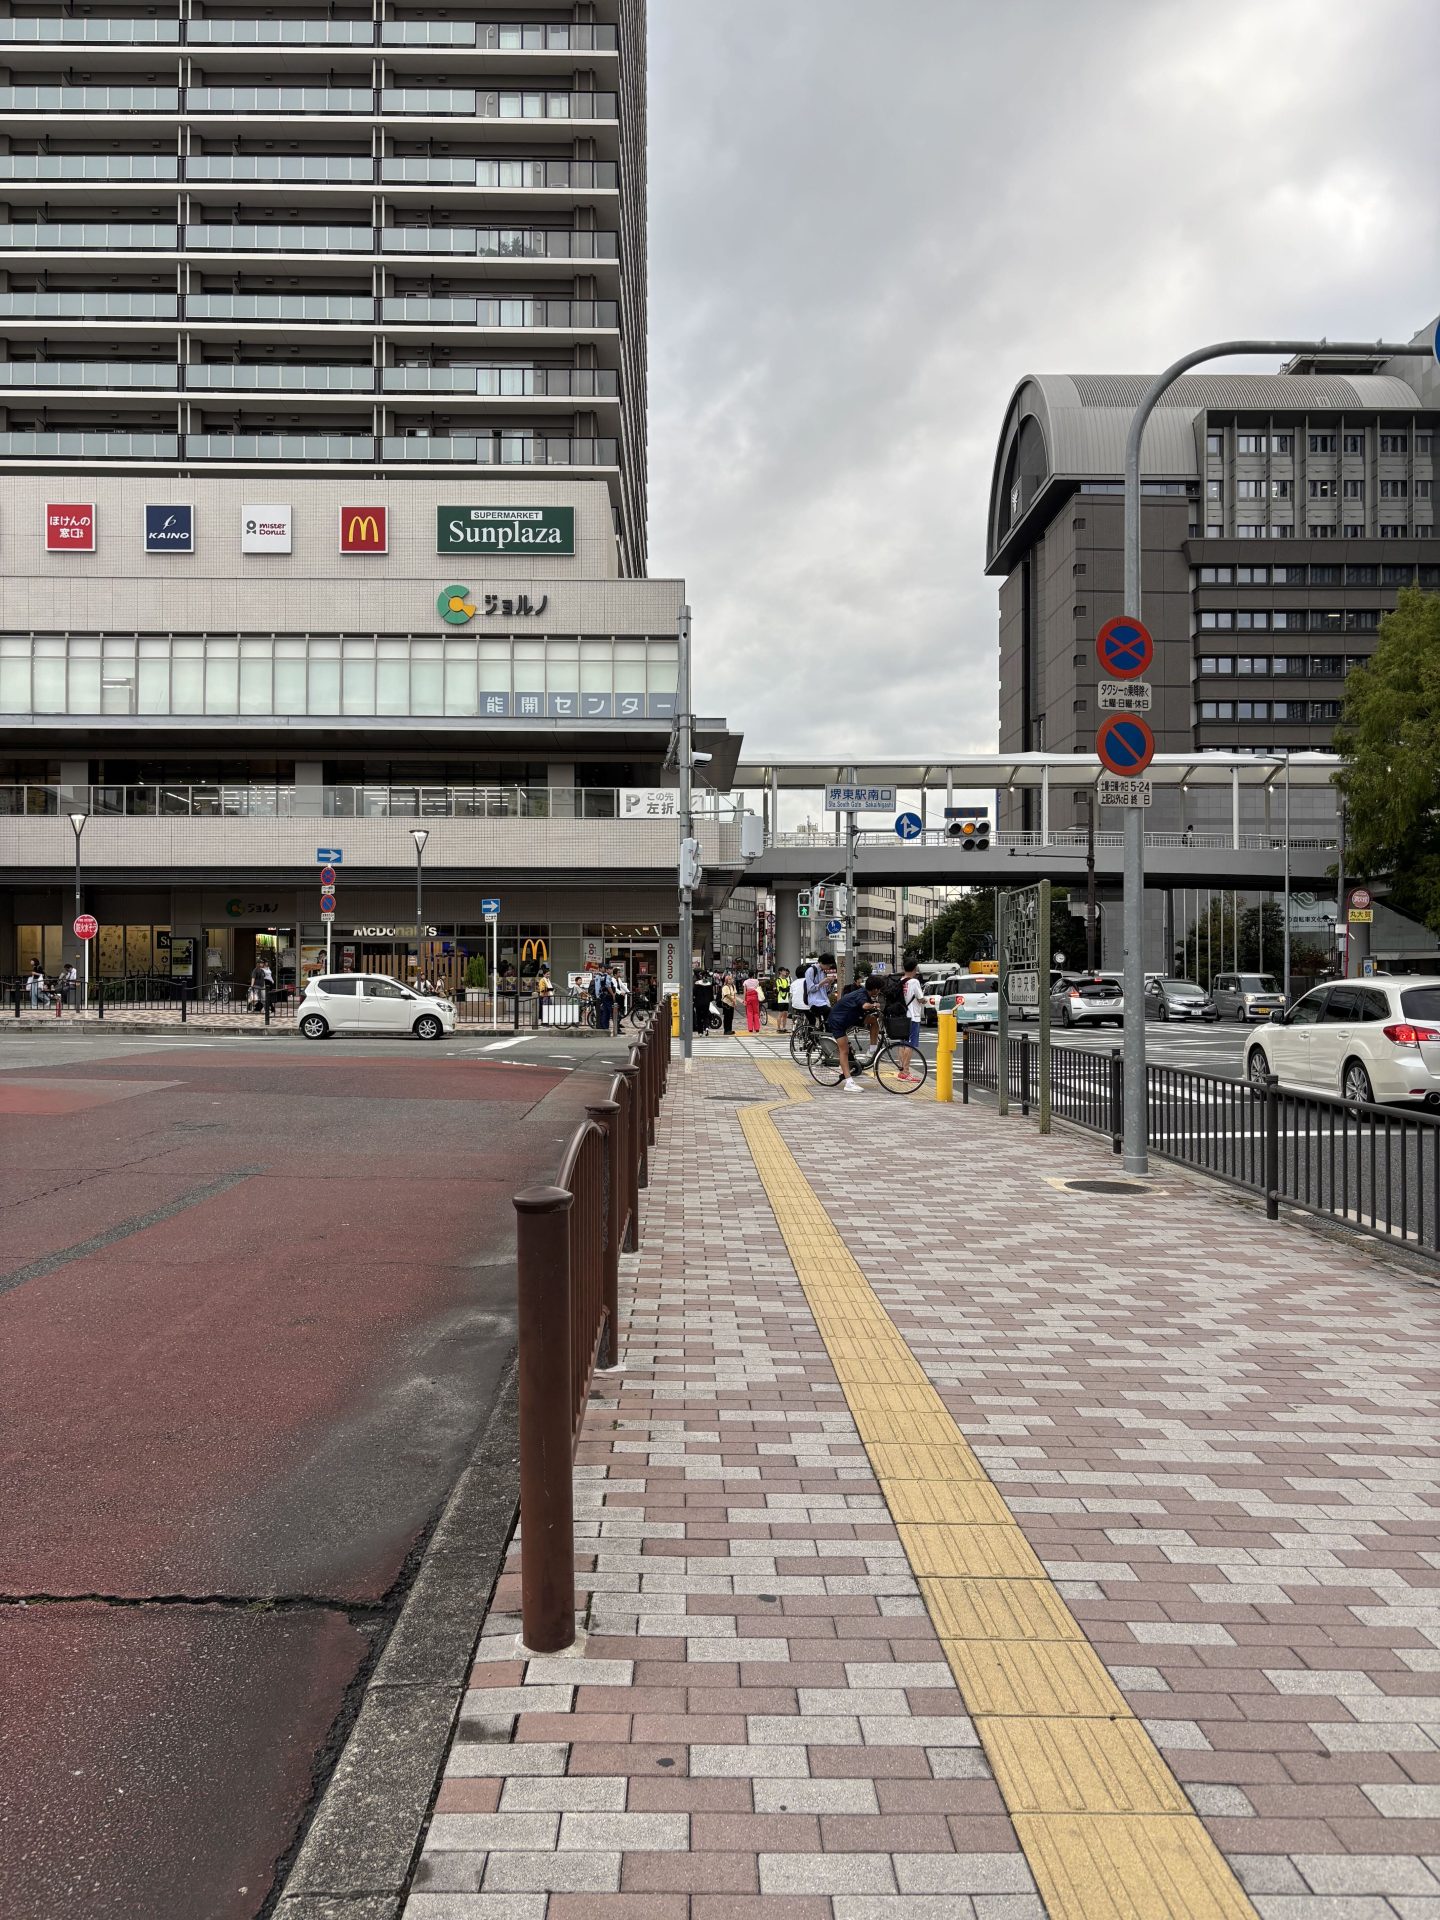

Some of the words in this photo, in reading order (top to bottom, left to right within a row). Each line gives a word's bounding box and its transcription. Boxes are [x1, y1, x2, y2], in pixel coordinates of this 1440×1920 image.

[49, 516, 91, 526] ほけんの
[473, 511, 540, 519] SUPERMARKET
[449, 520, 563, 549] Sunplaza
[485, 594, 548, 616] ジョルノ
[1101, 684, 1149, 697] タクシーの乗降除く
[486, 696, 671, 714] 能開センター
[1130, 781, 1150, 793] 5-24
[647, 792, 674, 802] この先
[829, 788, 892, 801] 堺東駅南口
[625, 793, 641, 813] P
[646, 802, 674, 815] 左折
[247, 903, 279, 913] ジョルノ
